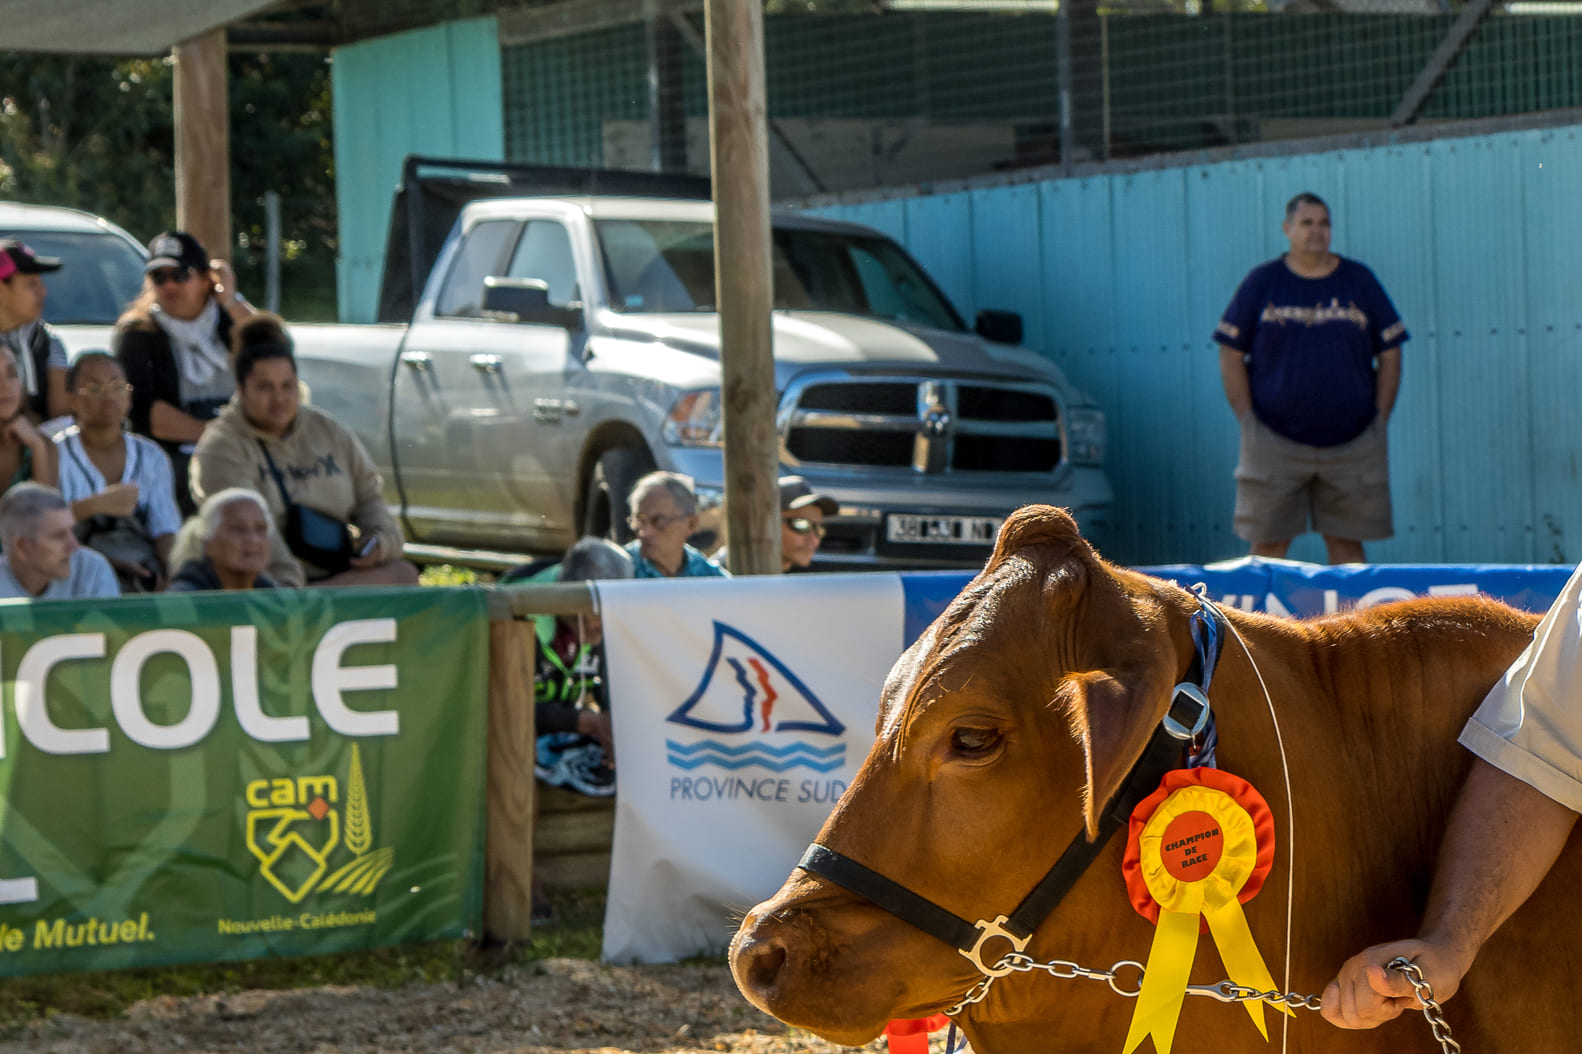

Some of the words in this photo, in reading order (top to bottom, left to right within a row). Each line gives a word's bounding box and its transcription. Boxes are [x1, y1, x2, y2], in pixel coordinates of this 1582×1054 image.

[0, 618, 399, 759] COLE
[246, 775, 338, 807] cam
[670, 776, 792, 802] PROVINCE
[797, 779, 848, 803] SUD
[1165, 828, 1219, 852] CHAMPION
[1184, 846, 1198, 856] DE
[1181, 853, 1208, 869] RACE
[34, 912, 155, 950] Mutuel.
[217, 907, 377, 935] Nouvelle-Calédonie
